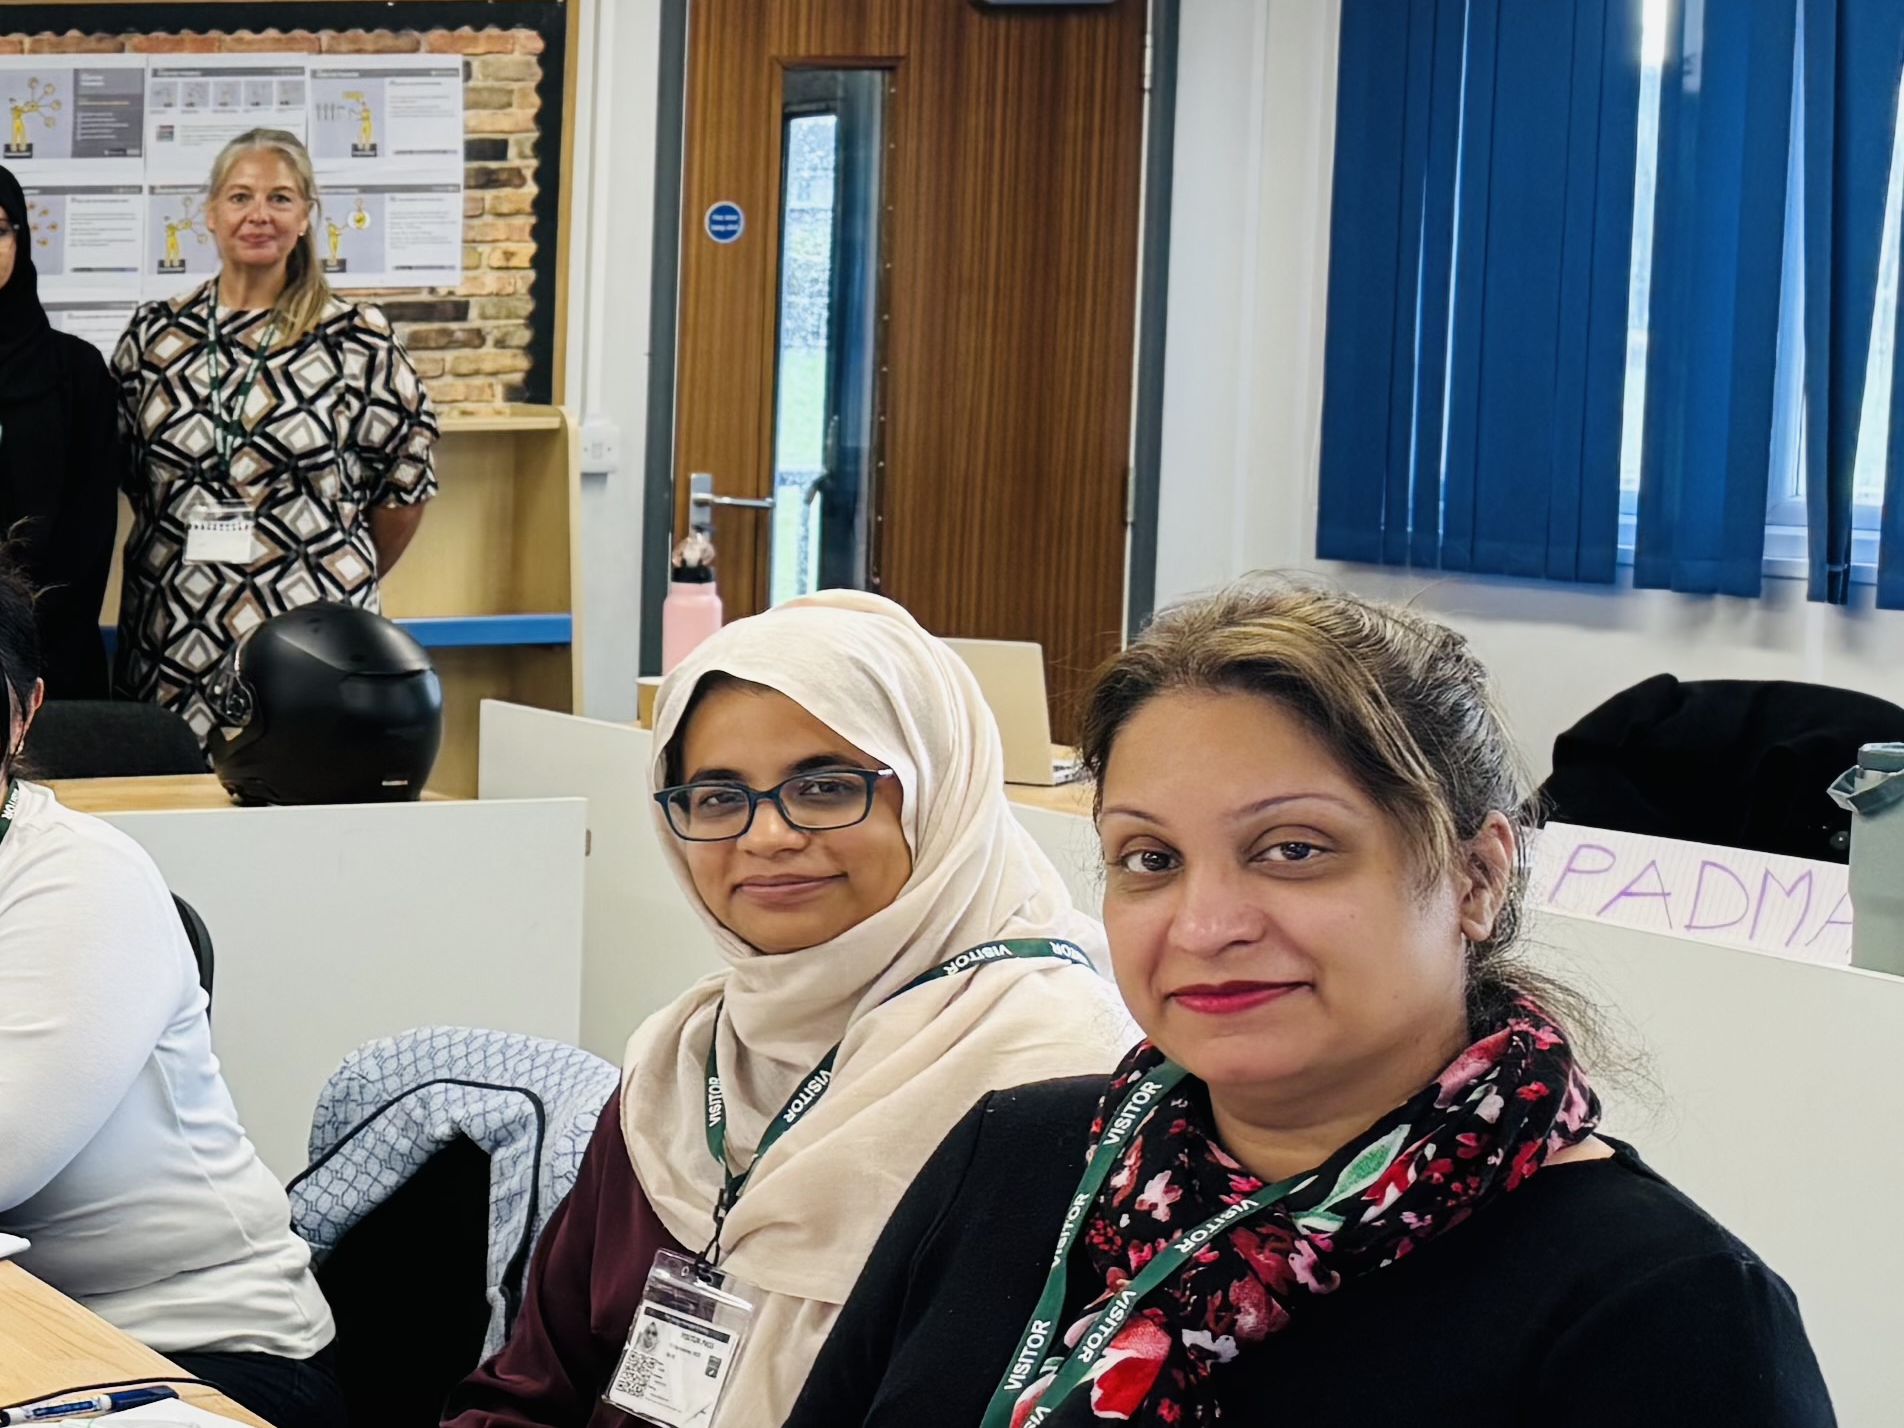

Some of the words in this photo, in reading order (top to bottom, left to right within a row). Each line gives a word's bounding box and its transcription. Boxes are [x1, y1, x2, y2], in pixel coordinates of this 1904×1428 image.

[943, 944, 1013, 976] VISITOR
[783, 1069, 833, 1124] VISITOR
[1103, 1080, 1162, 1146] VISITOR
[1050, 1192, 1089, 1269] VISITOR
[1174, 1198, 1260, 1254] VISITOR
[1003, 1319, 1051, 1391] VISITOR
[1078, 1290, 1137, 1364] VISITOR
